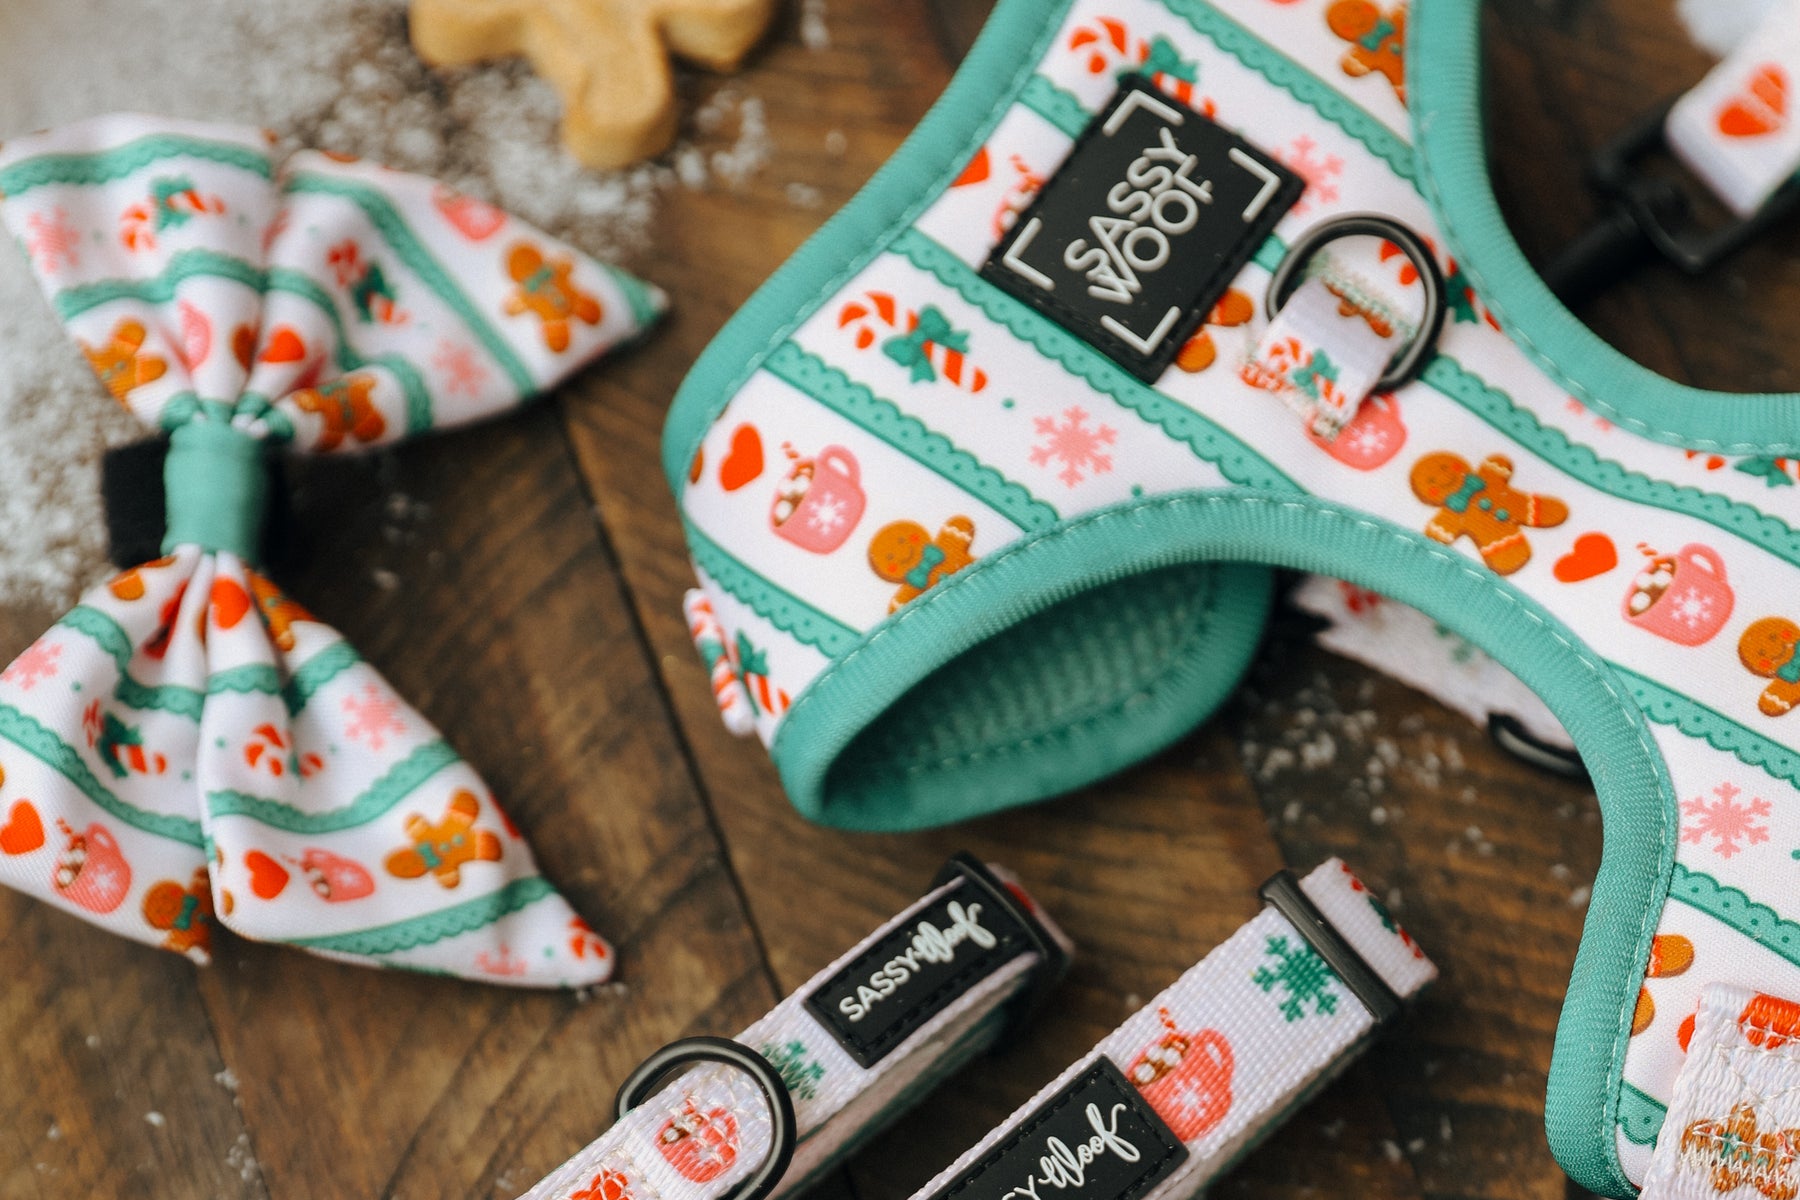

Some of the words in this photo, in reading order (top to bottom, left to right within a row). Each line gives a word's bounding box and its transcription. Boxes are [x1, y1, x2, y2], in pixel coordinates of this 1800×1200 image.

[1064, 126, 1194, 281] SASSY
[1087, 153, 1213, 303] WOOF
[838, 946, 921, 1022] SASSY
